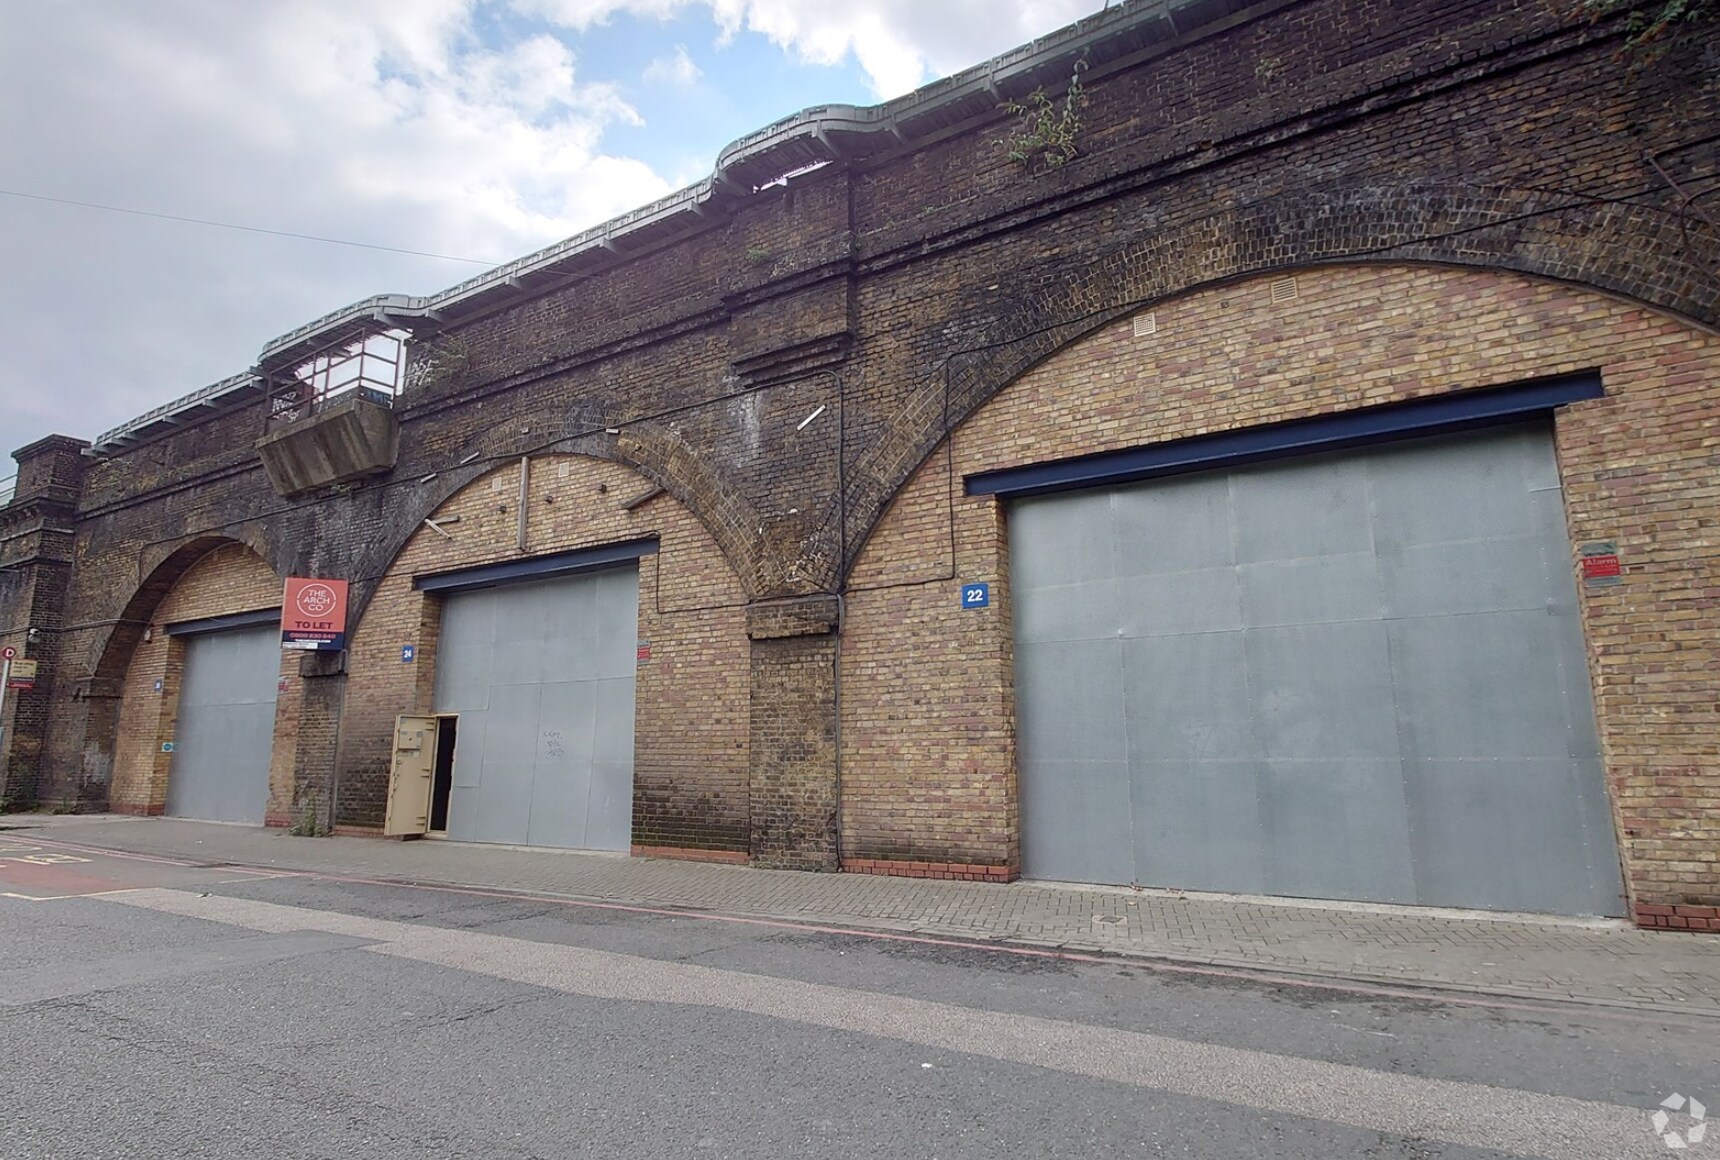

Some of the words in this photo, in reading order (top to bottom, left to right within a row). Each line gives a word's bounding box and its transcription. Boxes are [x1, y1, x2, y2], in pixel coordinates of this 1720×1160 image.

[309, 589, 327, 597] THE
[967, 589, 983, 602] 22
[295, 621, 311, 629] TO
[313, 621, 334, 629] LET
[6, 649, 14, 657] D
[404, 649, 412, 658] 24
